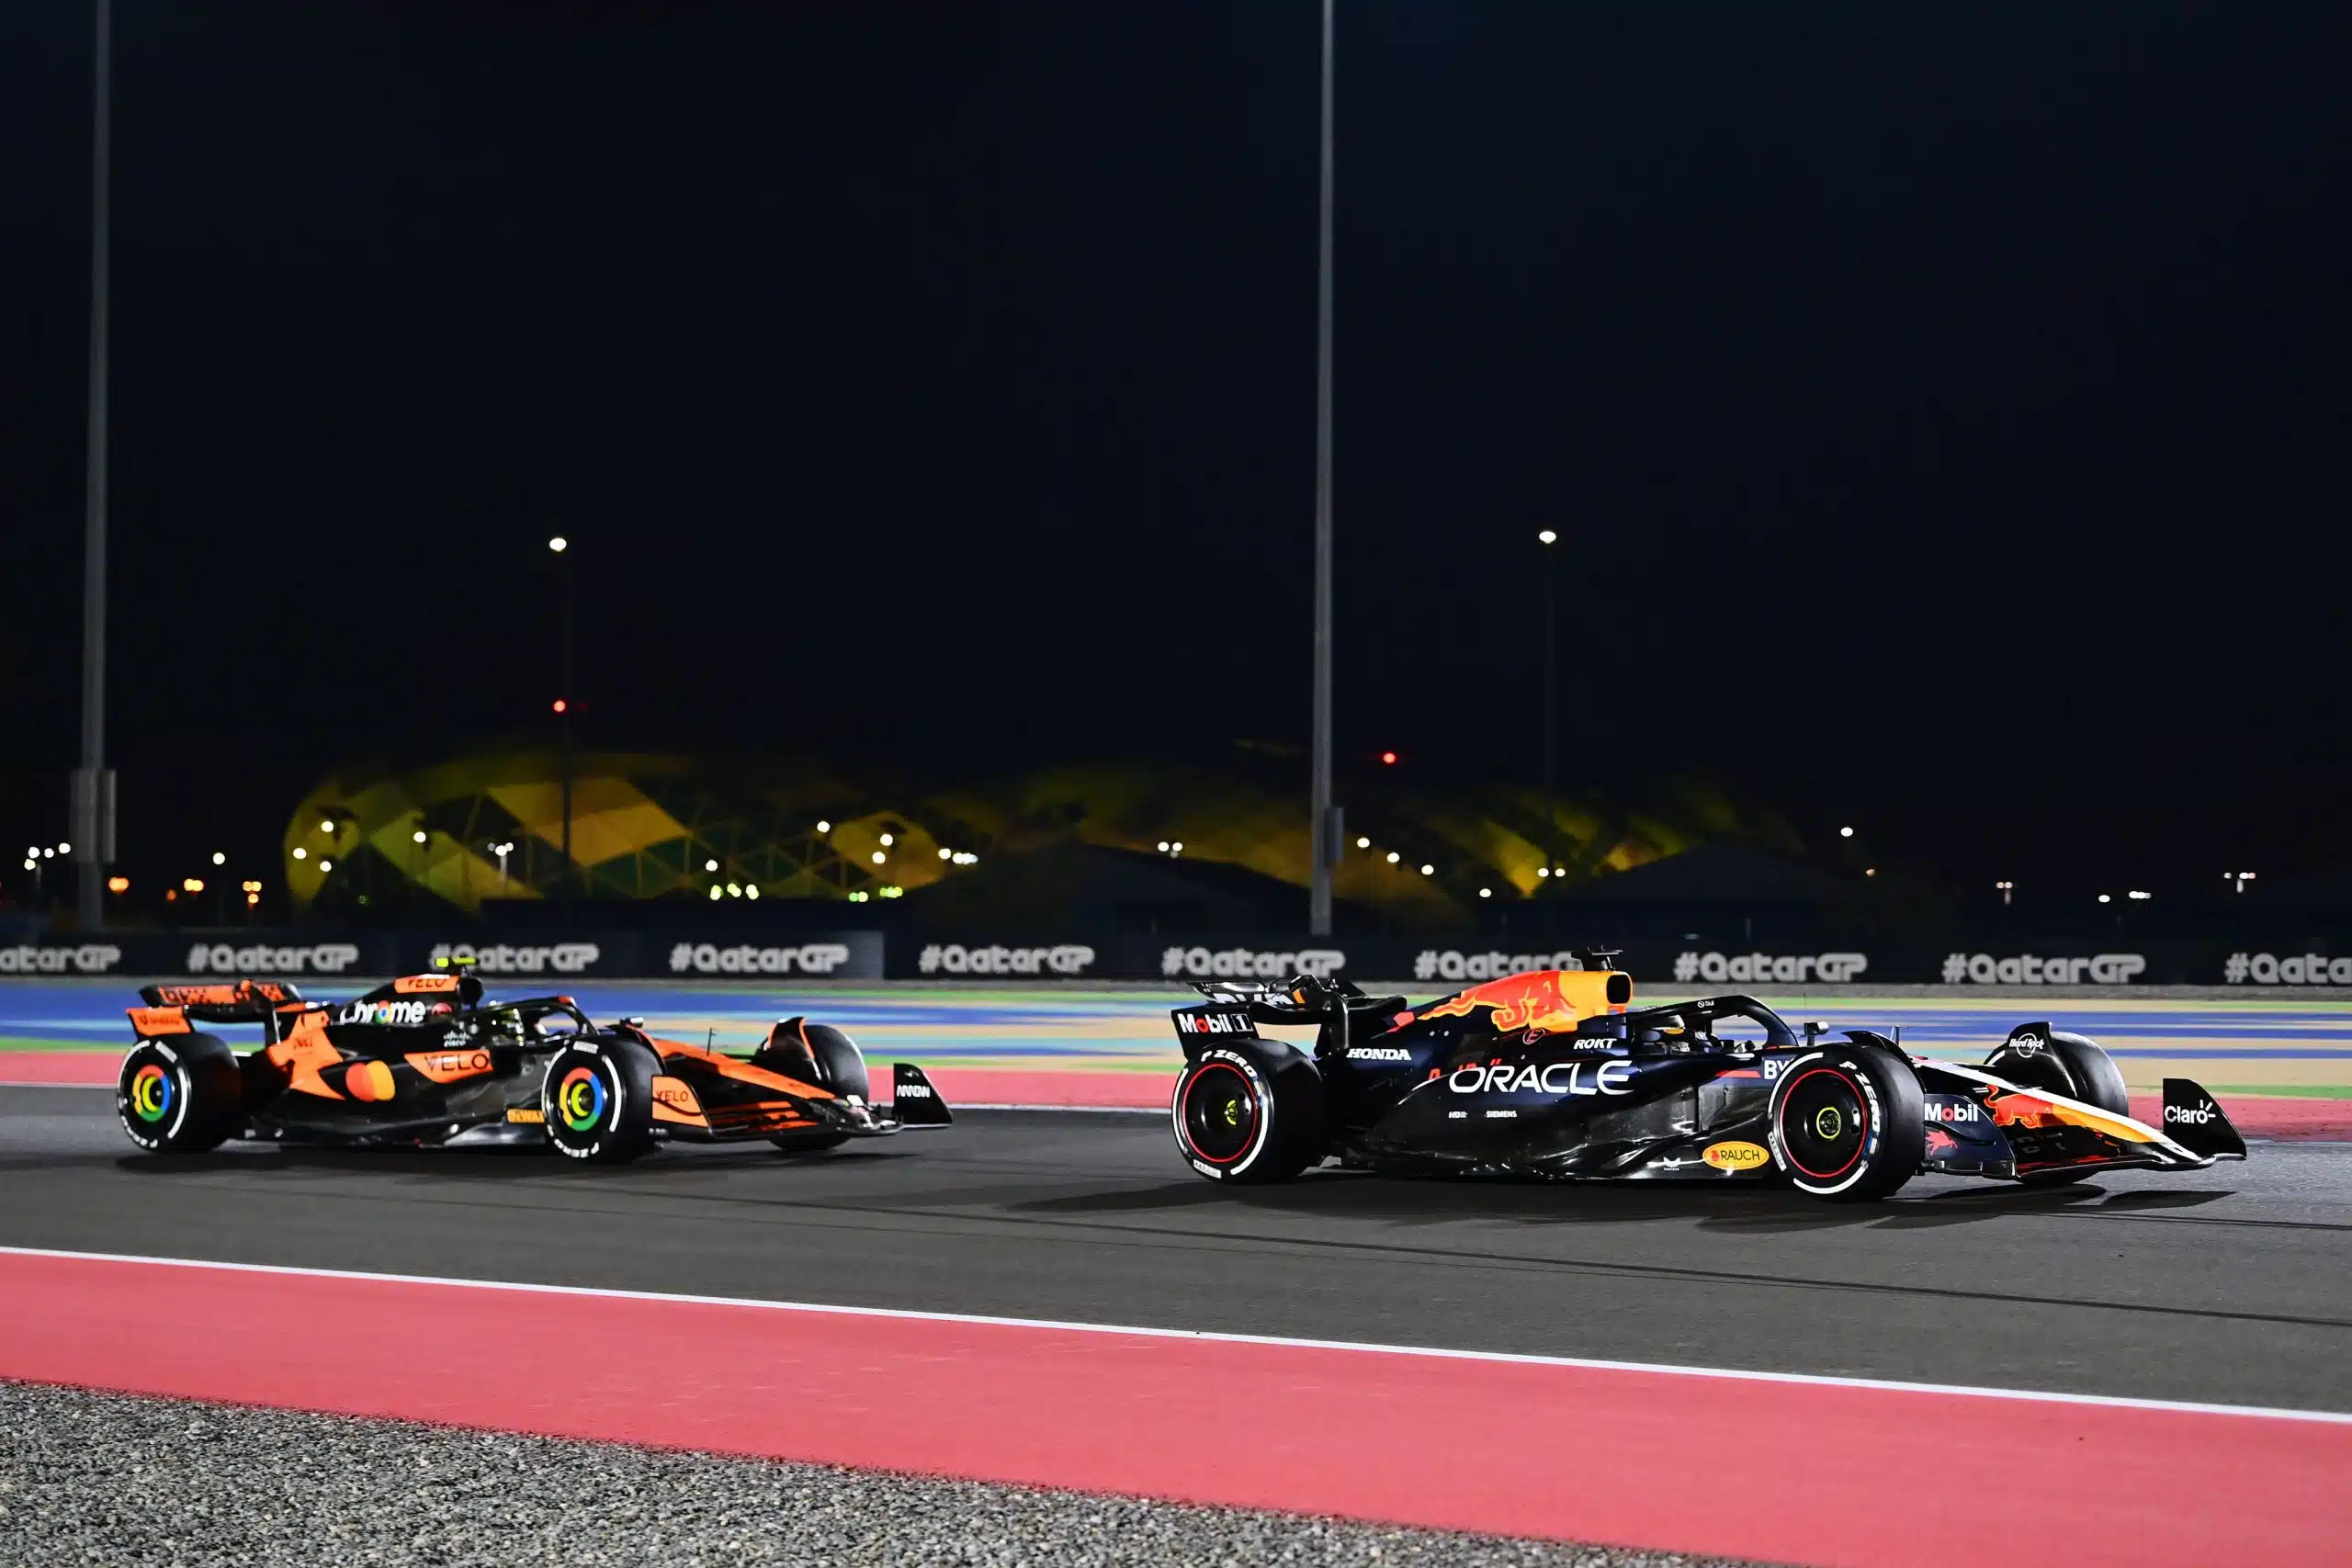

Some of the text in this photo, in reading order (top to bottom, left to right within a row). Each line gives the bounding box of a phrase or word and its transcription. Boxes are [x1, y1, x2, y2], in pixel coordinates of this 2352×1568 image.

[188, 943, 359, 972] #QatarGP
[669, 943, 849, 972] #QatarGP
[919, 945, 1094, 974] #QatarGP
[1161, 947, 1345, 976] #QatarGP
[1673, 952, 1868, 982] #QatarGP
[1942, 953, 2145, 983] #QatarGP
[1177, 1012, 1233, 1034] Mobil
[1346, 1048, 1412, 1061] HONDA
[1573, 1038, 1617, 1050] ROKT
[1213, 1049, 1259, 1079] ZERO
[1449, 1060, 1634, 1096] ORACLE
[1486, 1110, 1518, 1118] SIEMENS
[1924, 1102, 1979, 1122] Mobil
[2165, 1105, 2208, 1124] Claro
[1720, 1149, 1760, 1160] RAUCH
